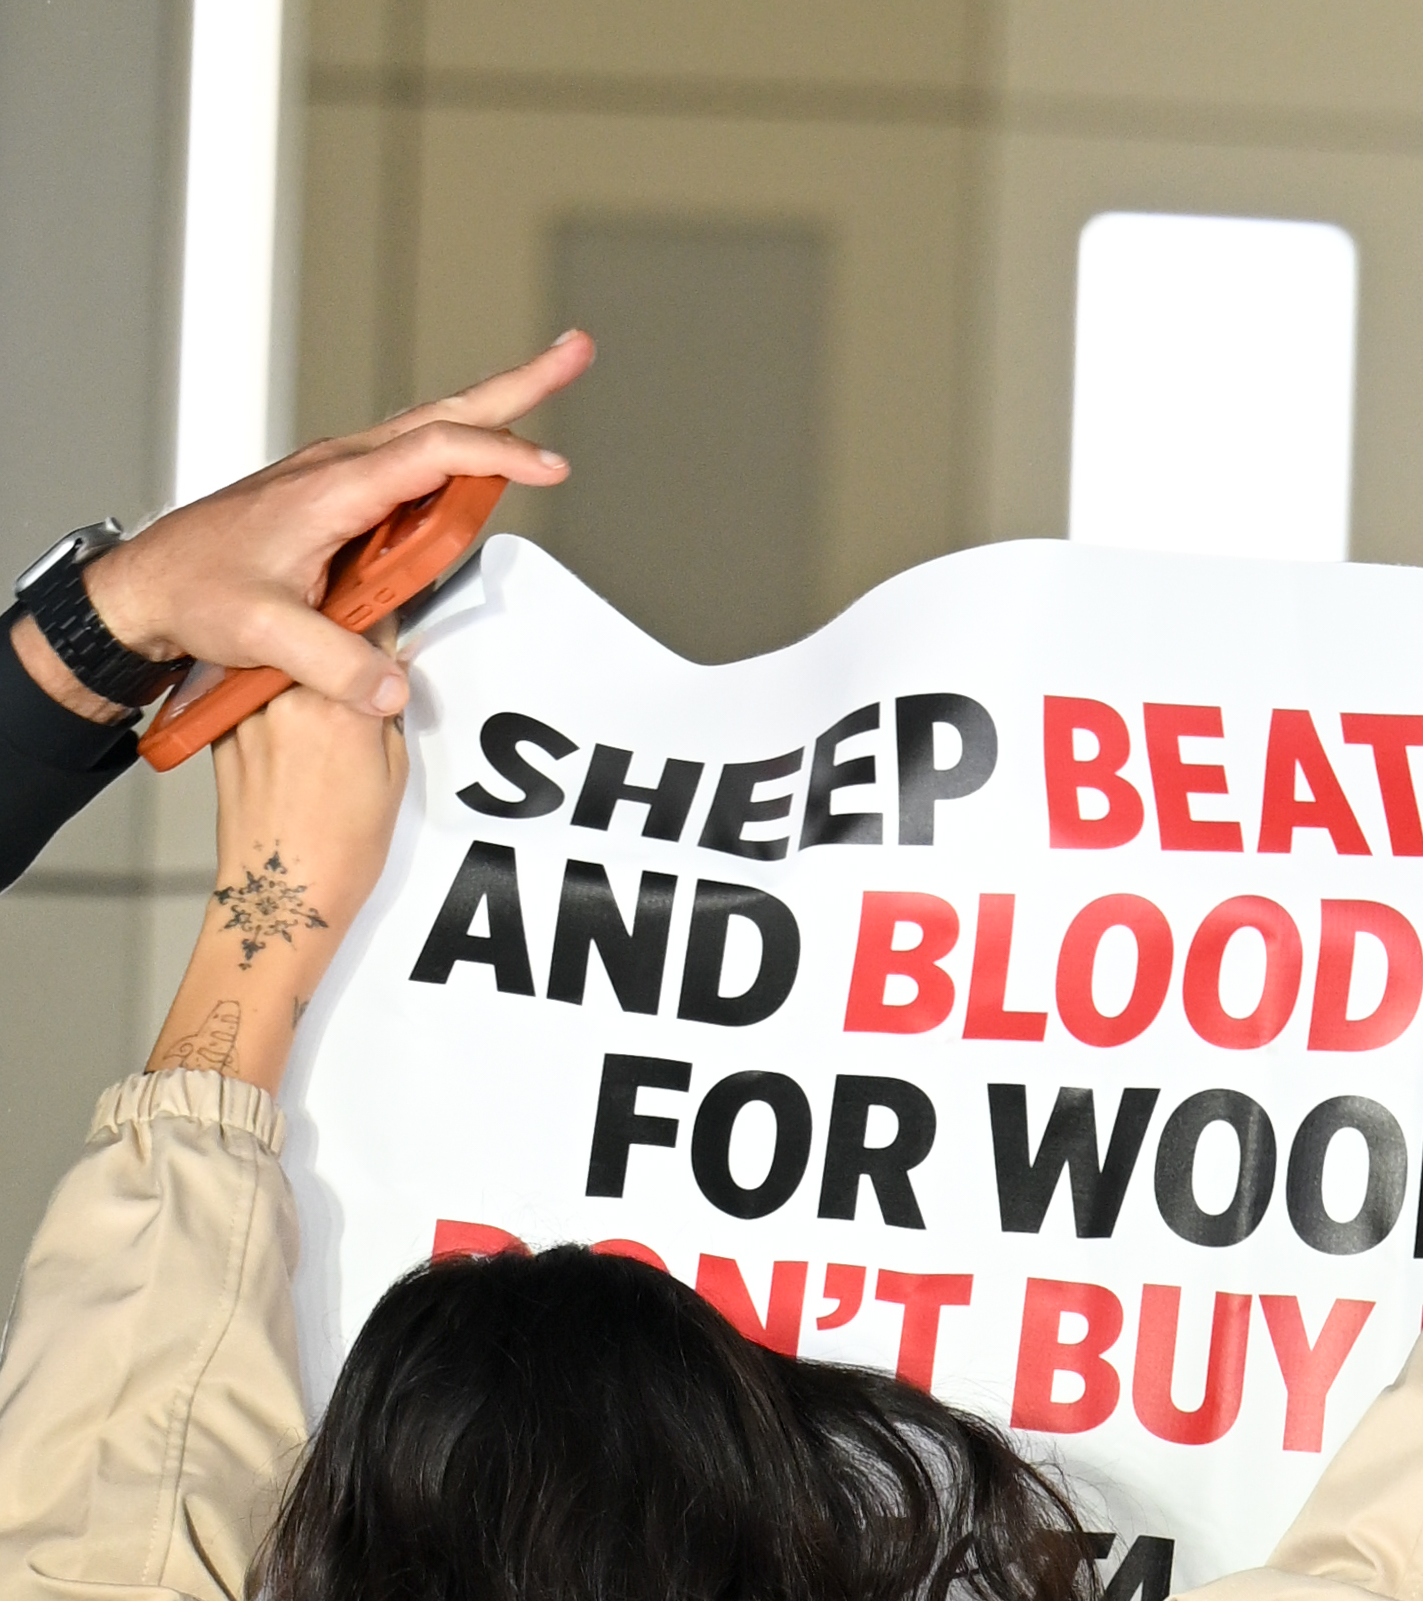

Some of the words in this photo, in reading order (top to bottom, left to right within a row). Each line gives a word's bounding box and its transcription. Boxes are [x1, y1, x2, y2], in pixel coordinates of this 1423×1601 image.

[456, 693, 998, 861] SHEEP
[409, 840, 800, 1027] AND
[585, 1053, 937, 1230] FOR
[432, 1219, 974, 1395] N'T
[1010, 1277, 1375, 1452] BUY
